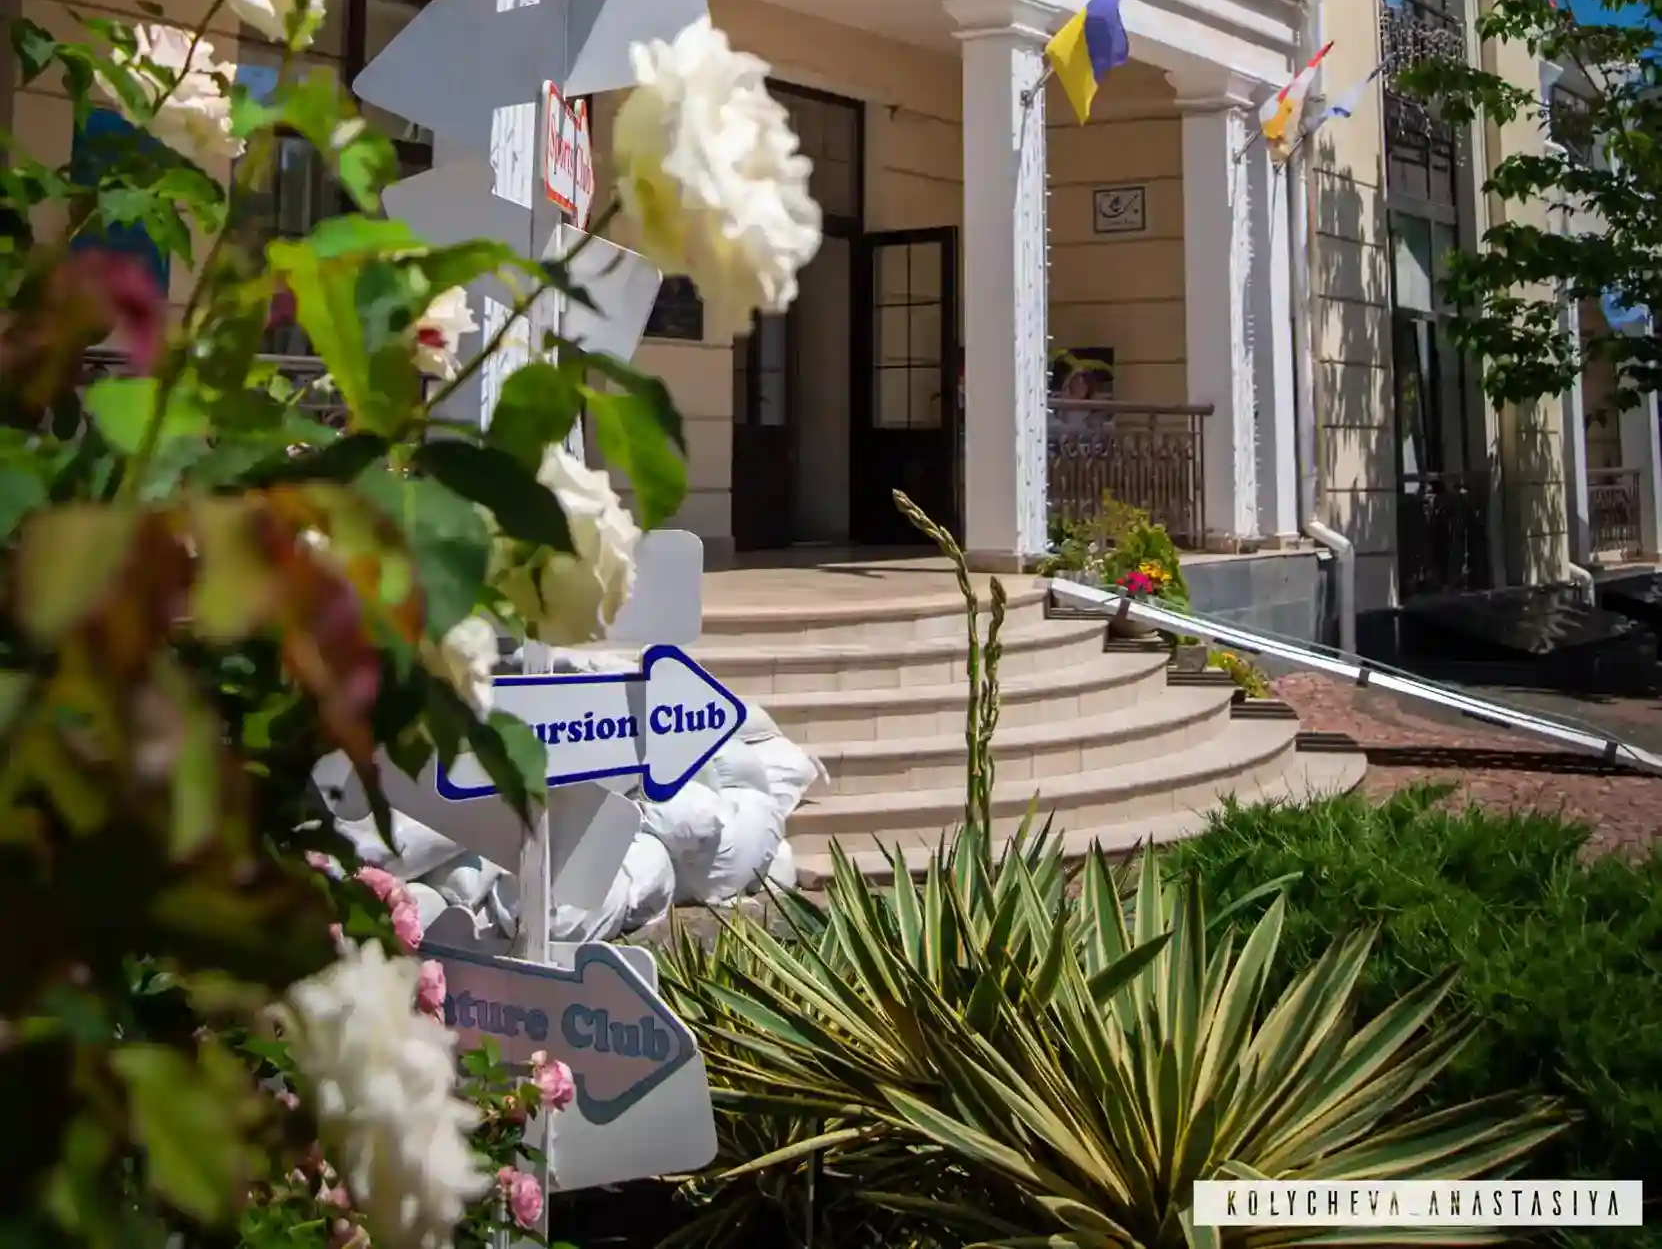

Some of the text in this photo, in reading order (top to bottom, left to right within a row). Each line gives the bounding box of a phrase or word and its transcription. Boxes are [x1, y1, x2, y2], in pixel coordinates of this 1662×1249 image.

[529, 701, 727, 745] ursion Club
[561, 1003, 671, 1062] Club
